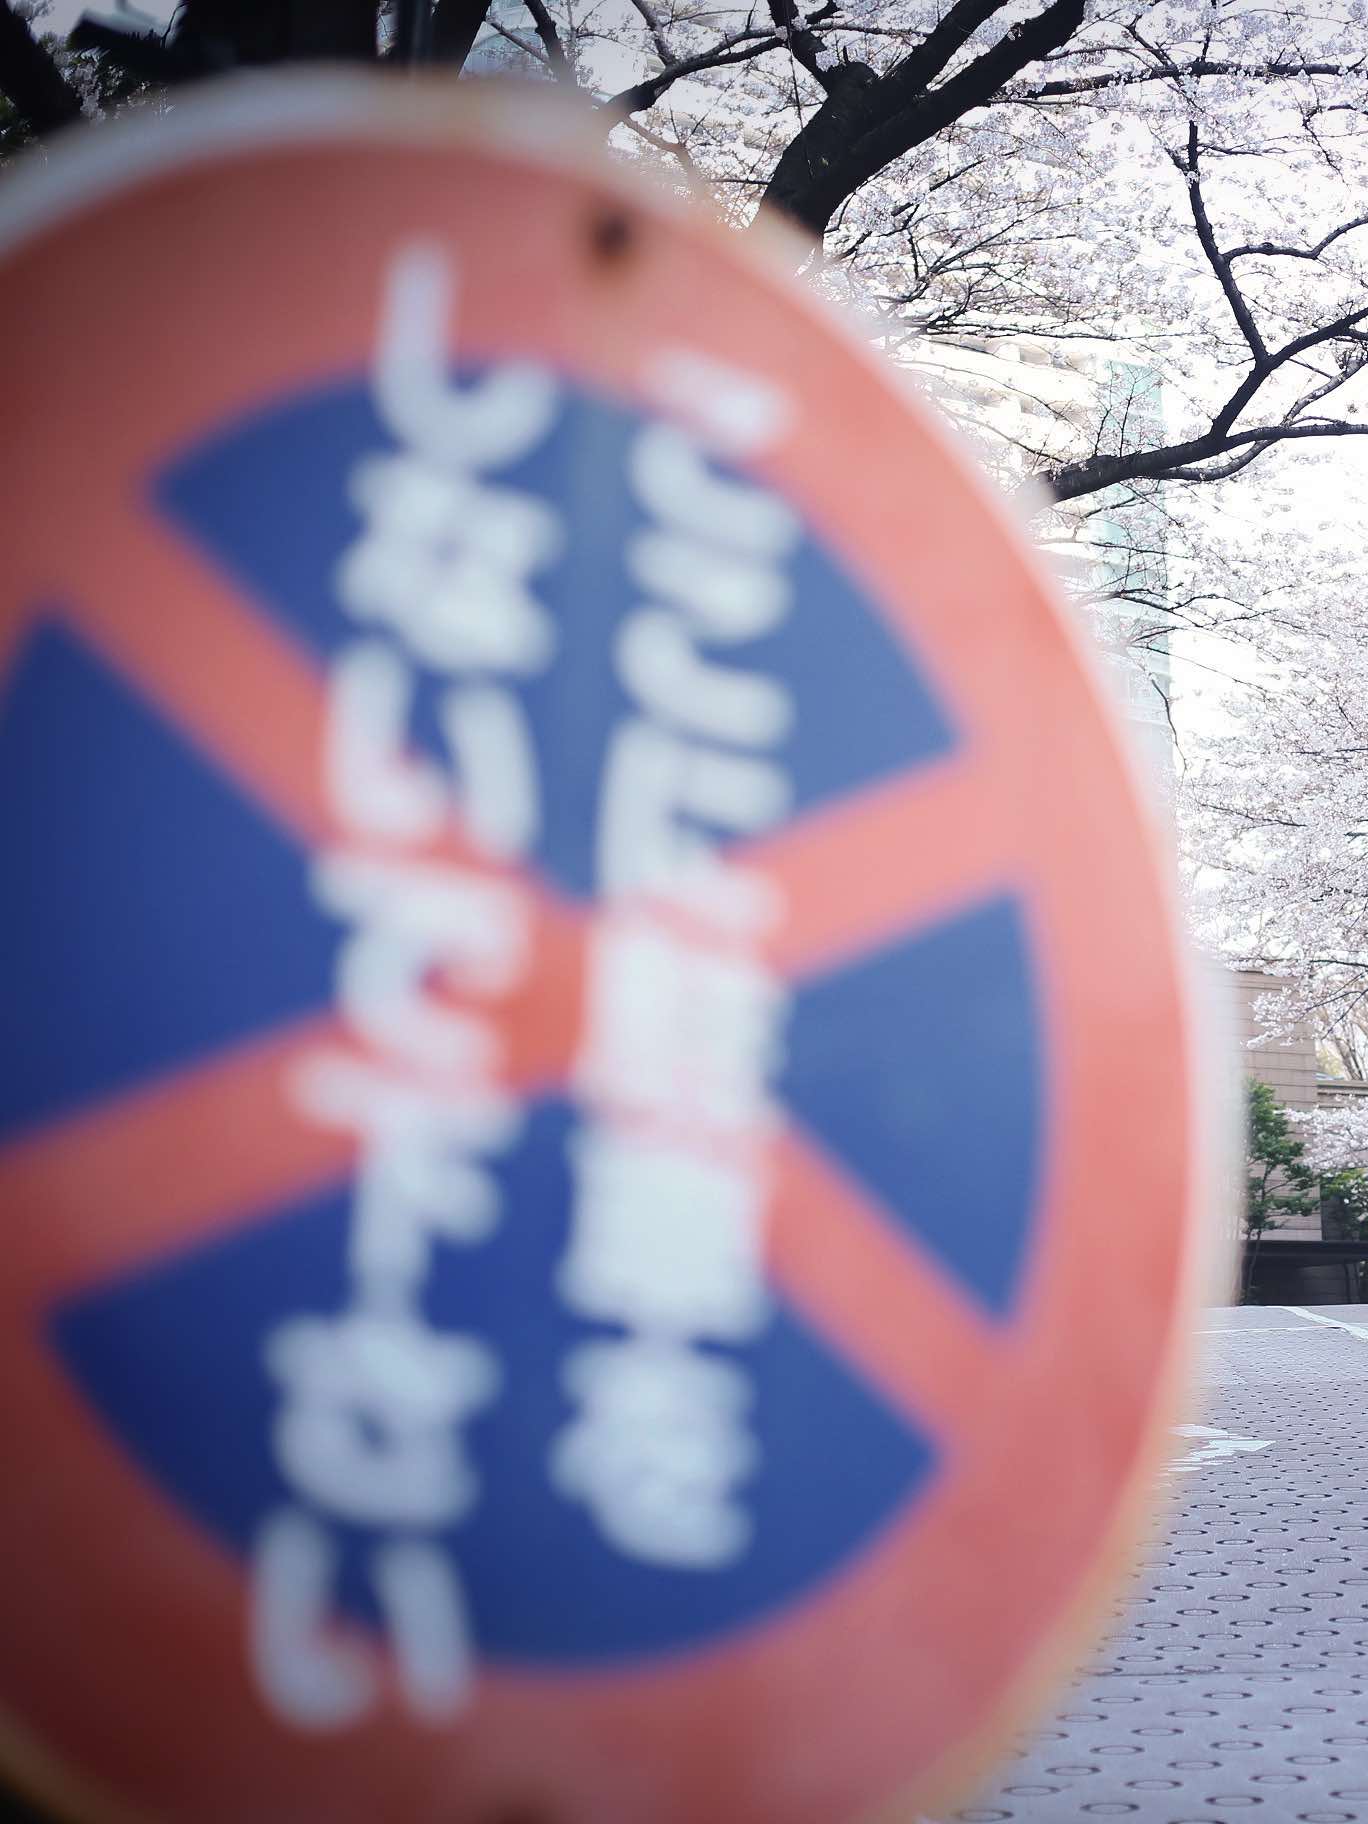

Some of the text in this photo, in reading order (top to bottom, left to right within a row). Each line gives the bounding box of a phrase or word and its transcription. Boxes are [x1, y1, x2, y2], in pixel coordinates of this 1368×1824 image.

[254, 236, 562, 1726] しないで下さい
